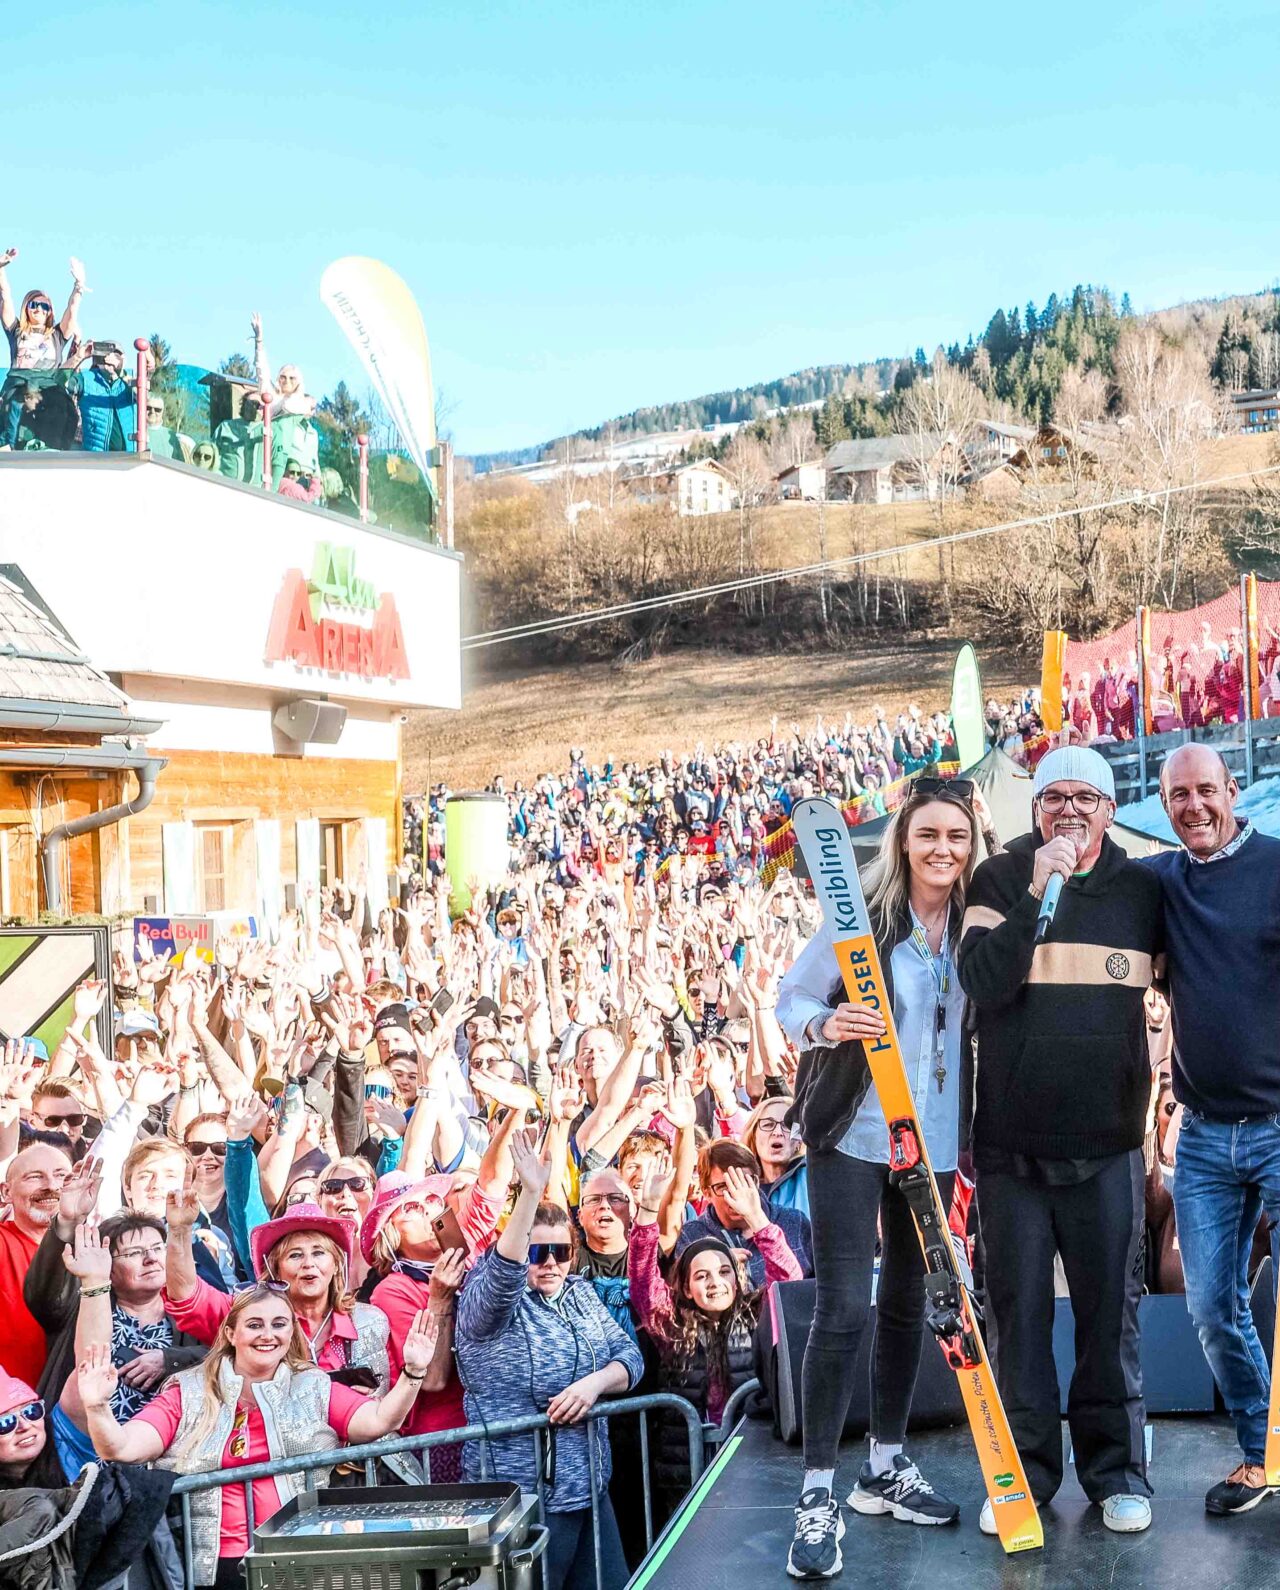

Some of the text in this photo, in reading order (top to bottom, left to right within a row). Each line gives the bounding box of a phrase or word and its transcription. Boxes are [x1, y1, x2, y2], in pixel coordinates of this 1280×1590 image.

[815, 828, 859, 931] Kaibling
[176, 924, 207, 940] Bull
[850, 948, 891, 1053] HUSER
